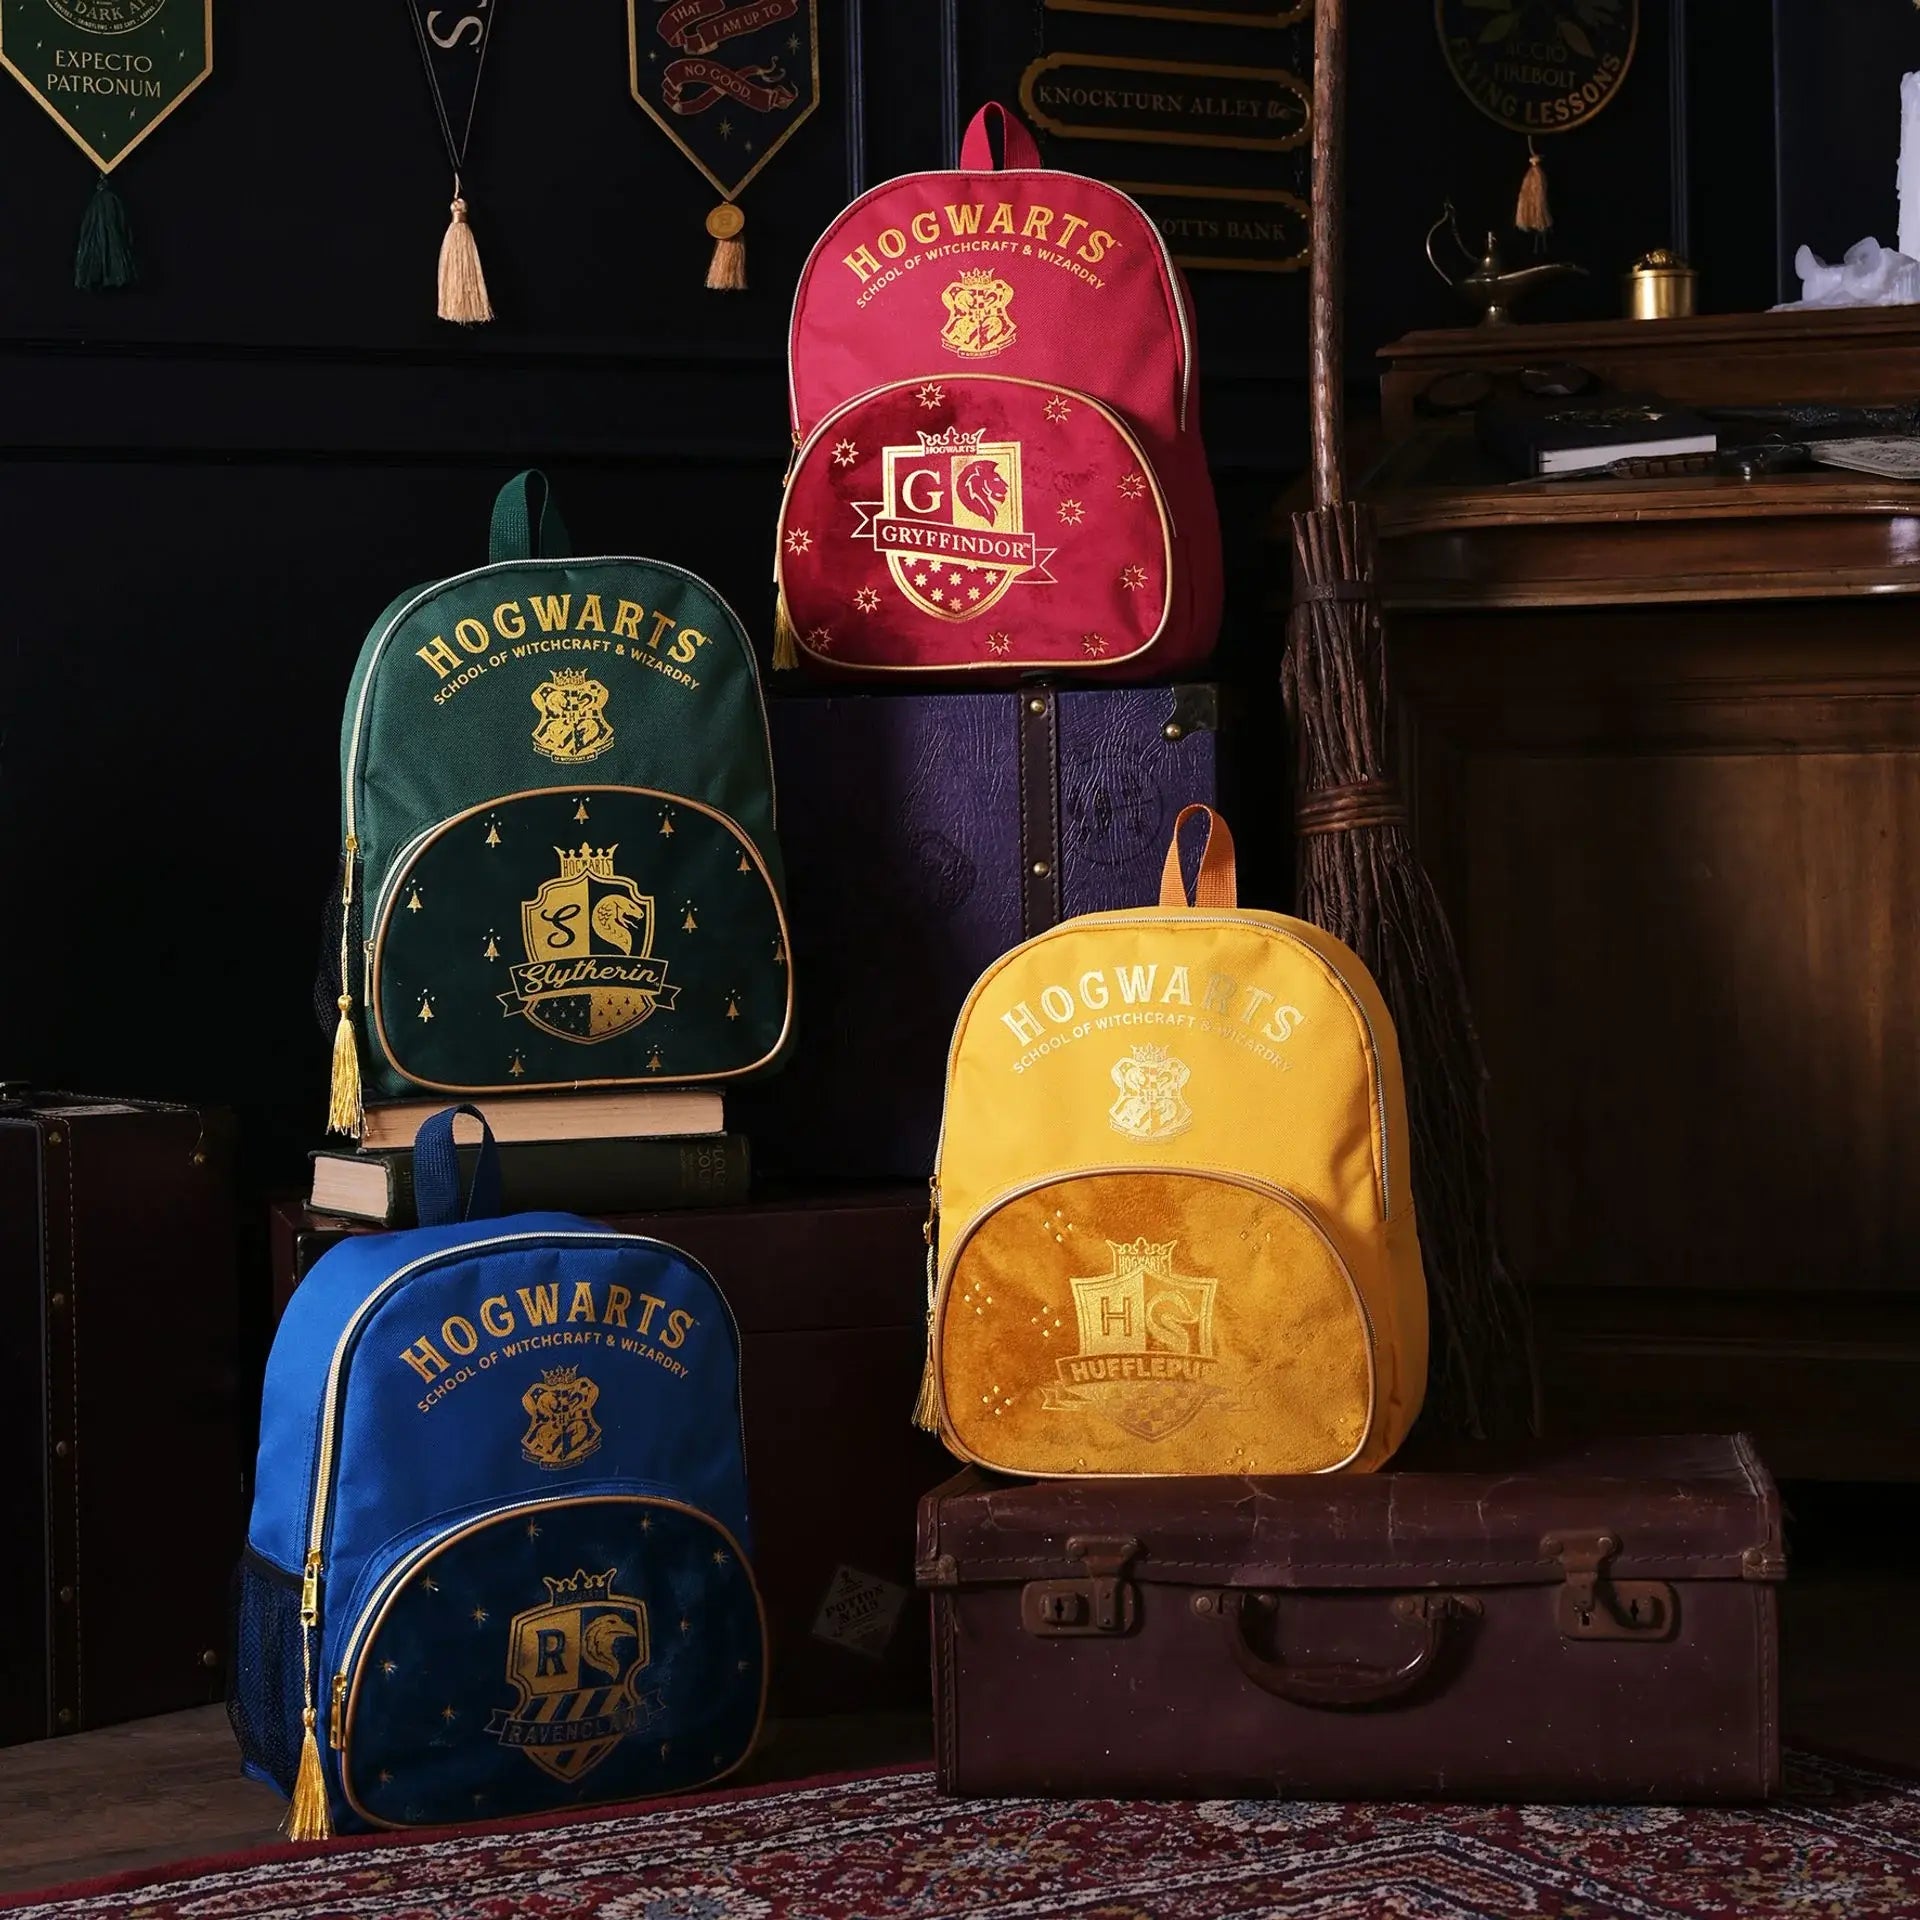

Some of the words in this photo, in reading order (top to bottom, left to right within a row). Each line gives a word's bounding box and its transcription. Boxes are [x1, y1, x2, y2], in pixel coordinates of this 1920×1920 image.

[75, 2, 124, 21] DARK
[670, 2, 701, 23] THAT
[713, 24, 719, 37] I
[723, 19, 741, 34] AM
[744, 11, 759, 26] UP
[762, 3, 782, 18] TO
[55, 50, 153, 73] EXPECTO
[684, 64, 706, 78] NO
[47, 73, 161, 98] PATRONUM
[1039, 85, 1183, 113] KNOCKTURN
[1189, 98, 1262, 118] ALLEY
[1525, 52, 1622, 125] LESSONS
[842, 203, 1118, 284] HOGWARTS
[1153, 217, 1220, 239] OTTS
[1227, 221, 1286, 242] BANK
[856, 267, 903, 308] SCHOOL
[904, 255, 922, 270] OF
[925, 240, 1018, 261] WITCHCRAFT
[1022, 245, 1032, 256] &
[1038, 248, 1106, 290] WIZARDRY
[925, 444, 977, 455] HOGWARTS
[902, 469, 944, 514] G
[882, 525, 1027, 559] GRYFFINDOR
[415, 593, 708, 680] HOGWARTS
[433, 662, 487, 706] SCHOOL
[489, 652, 508, 668] OF
[511, 638, 611, 658] WITCHCRAFT
[615, 644, 625, 656] &
[630, 647, 700, 691] WIZARDRY
[563, 858, 613, 877] HOGWARTS
[540, 903, 582, 949] S
[518, 959, 659, 994] Slytherin
[1000, 964, 1305, 1047] HOGWARTS
[1012, 1032, 1071, 1075] SCHOOL
[1072, 1022, 1091, 1039] OF
[1095, 1012, 1196, 1030] WITCHCRAFT
[1118, 1255, 1167, 1273] HOGWARTS
[399, 1281, 695, 1385] HOGWARTS
[1101, 1296, 1132, 1336] H
[417, 1366, 476, 1413] SCHOOL
[478, 1352, 499, 1370] OF
[502, 1332, 601, 1358] WITCHCRAFT
[606, 1335, 616, 1347] &
[621, 1338, 689, 1380] WIZARDRY
[535, 1628, 567, 1677] R
